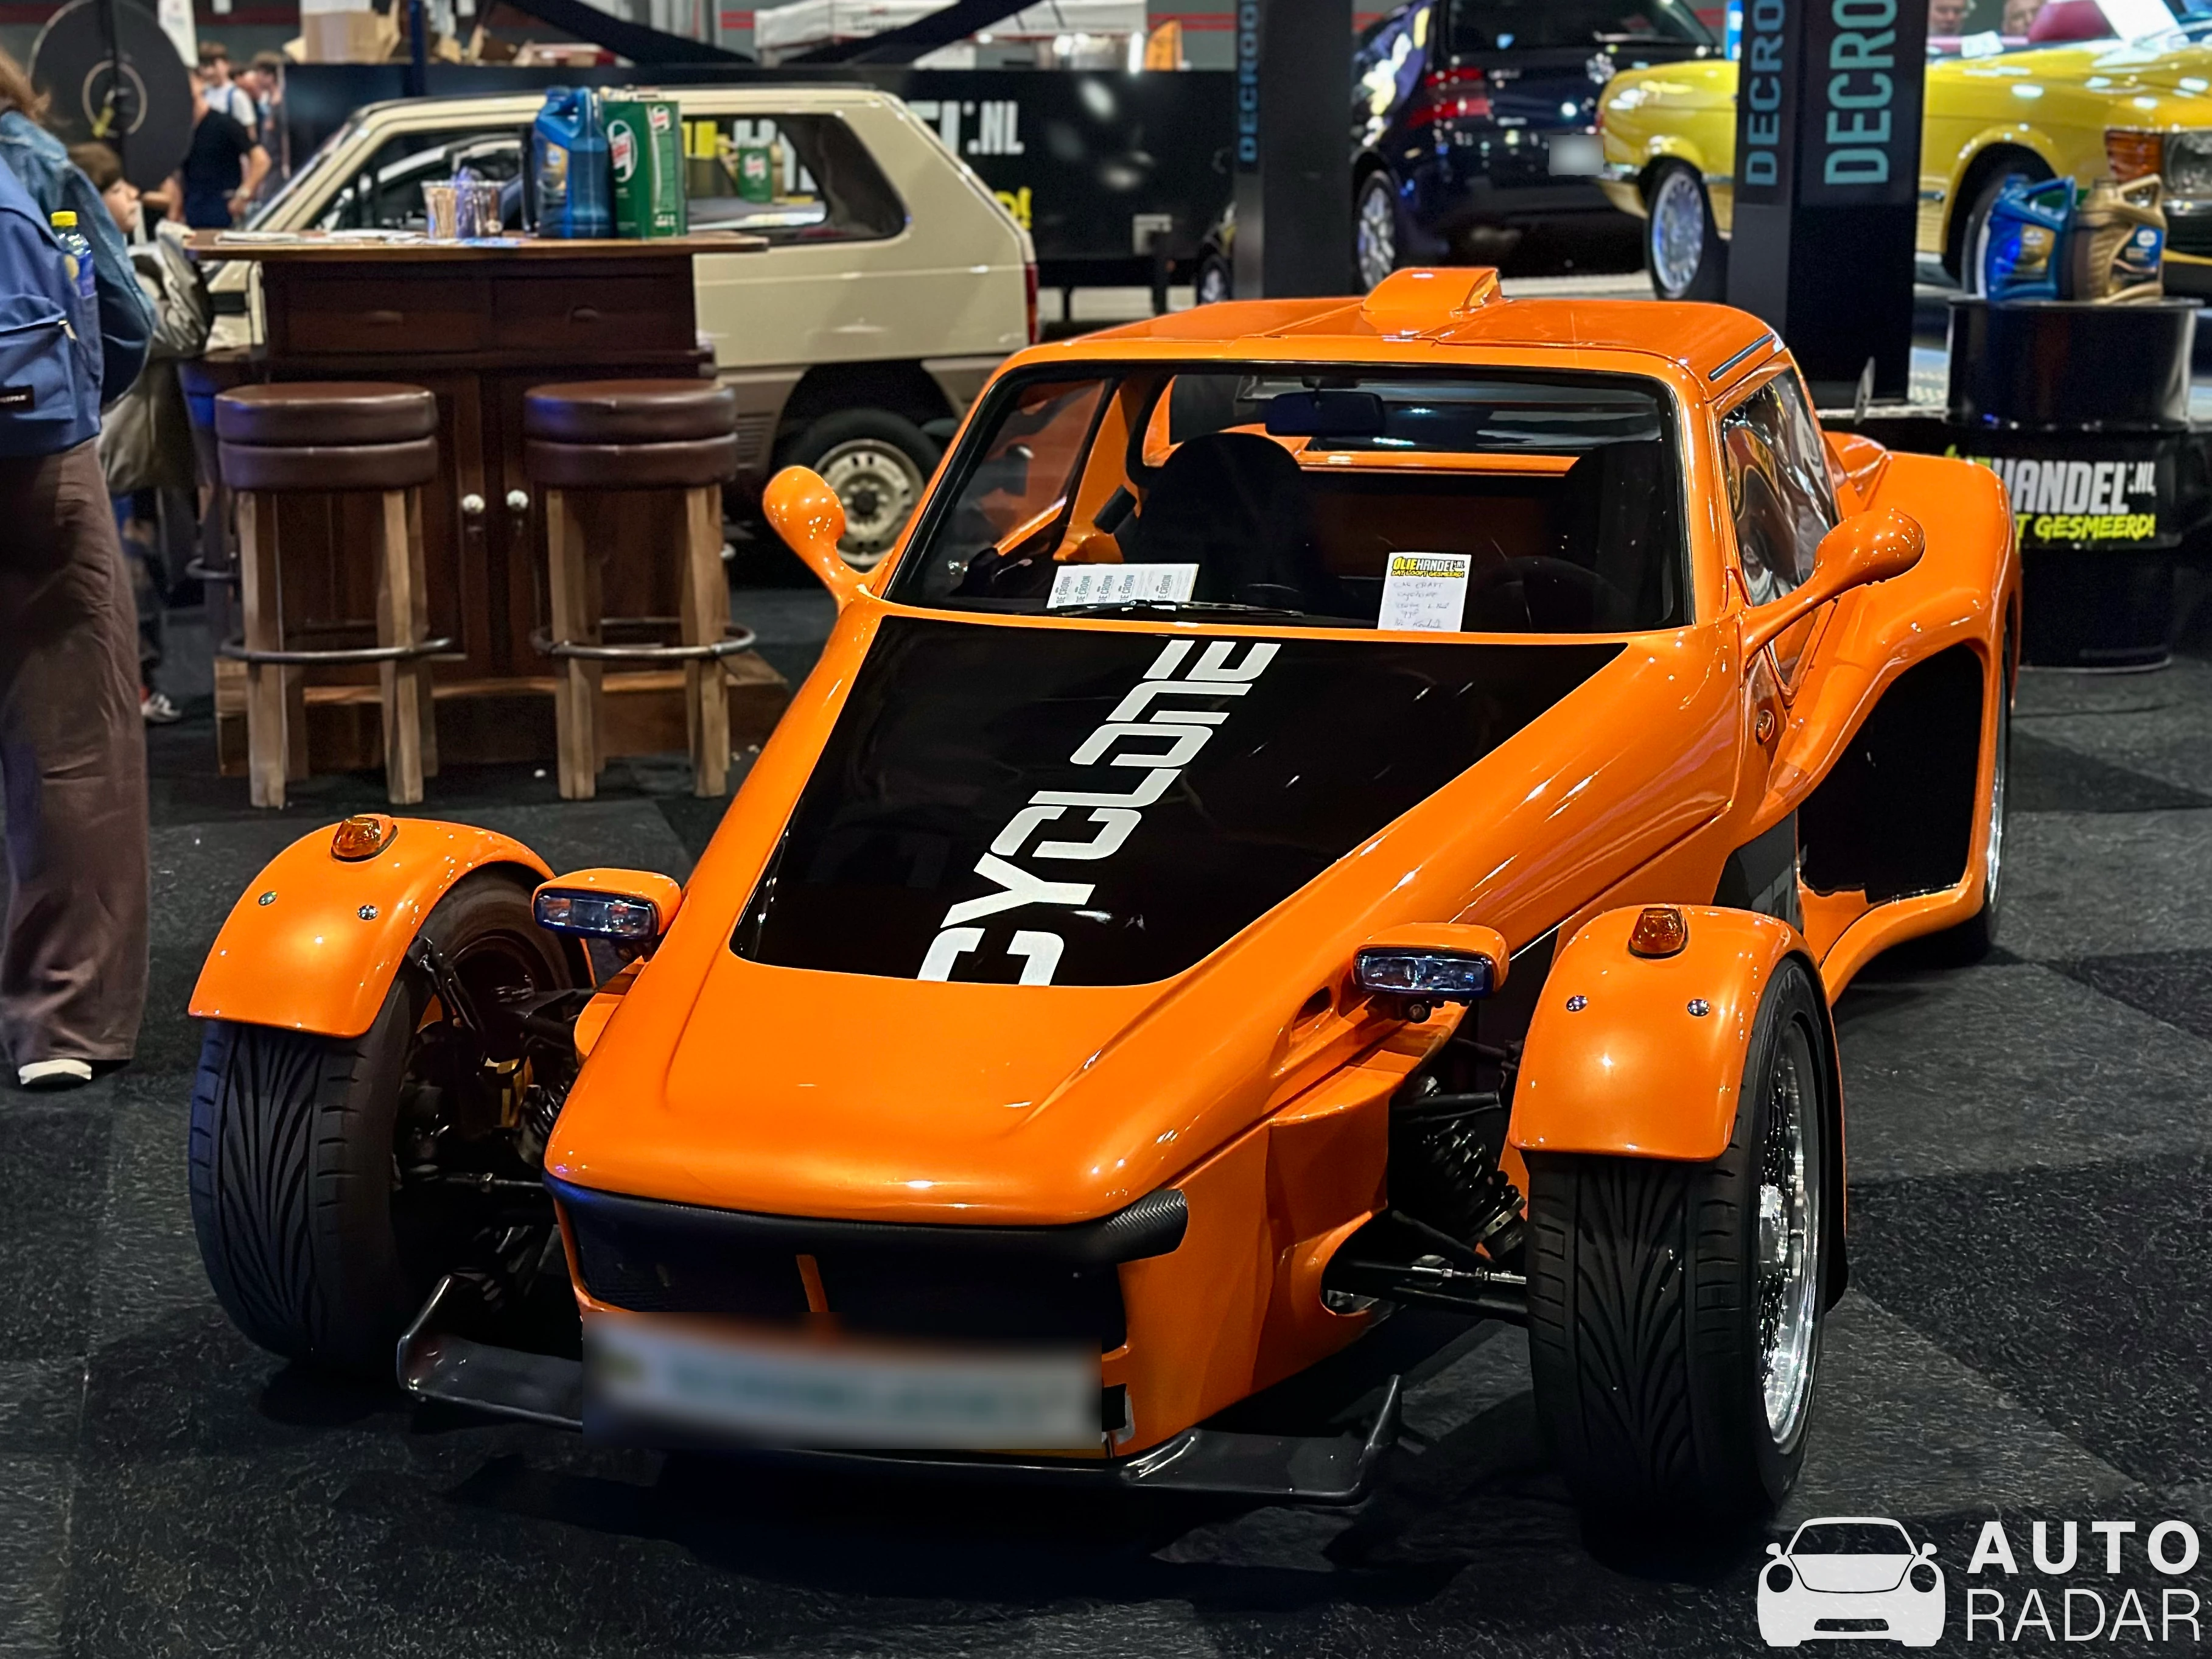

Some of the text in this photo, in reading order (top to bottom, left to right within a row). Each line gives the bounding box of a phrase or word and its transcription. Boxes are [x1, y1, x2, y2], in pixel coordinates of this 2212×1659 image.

[1238, 0, 1258, 162] DECROO
[1824, 0, 1898, 184] DECRO
[2034, 514, 2155, 541] GESMEERD!
[917, 640, 1281, 986] CYCLONE
